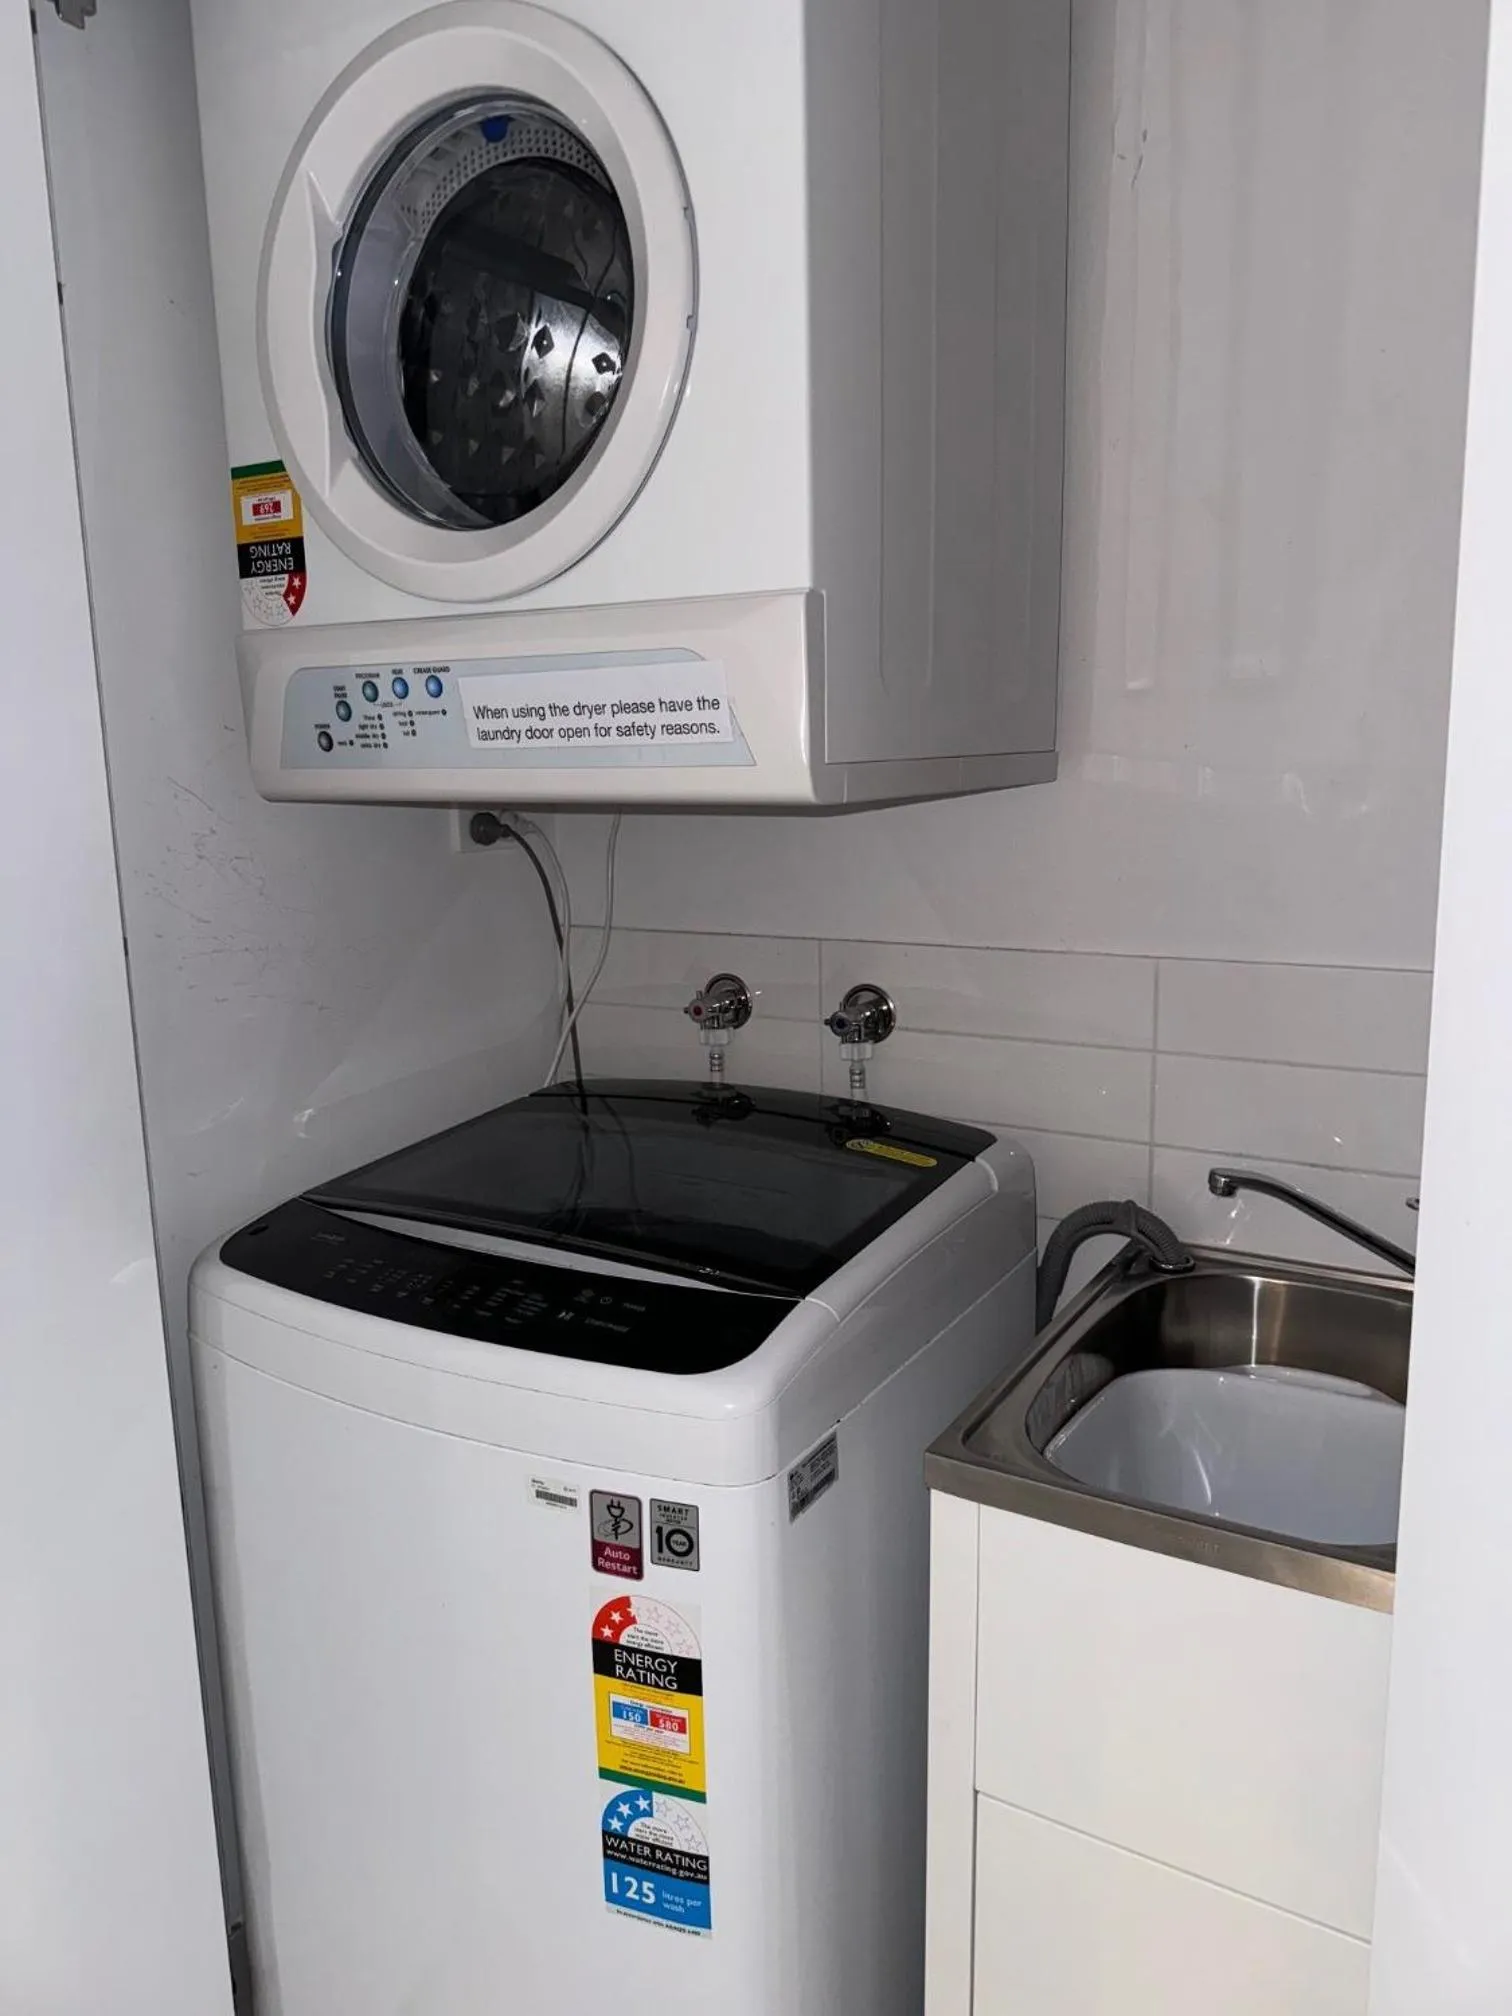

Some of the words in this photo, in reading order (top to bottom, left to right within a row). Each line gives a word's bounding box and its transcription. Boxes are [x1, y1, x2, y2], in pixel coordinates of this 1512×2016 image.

[250, 542, 291, 558] RATING
[250, 557, 294, 574] ENERGY
[473, 704, 509, 720] When
[511, 703, 546, 721] using
[548, 702, 570, 717] the
[573, 701, 606, 719] dryer
[611, 699, 655, 718] please
[658, 695, 693, 712] have
[696, 695, 720, 711] the
[476, 725, 521, 744] laundry
[525, 725, 554, 740] door
[558, 726, 590, 742] open
[593, 722, 612, 738] for
[616, 721, 657, 740] safety
[660, 722, 720, 736] reasons.
[657, 1504, 689, 1516] SMART
[604, 1546, 630, 1560] Auto
[656, 1525, 694, 1558] 10
[597, 1556, 638, 1575] Restart
[614, 1648, 678, 1674] ENERGY
[615, 1664, 678, 1690] RATING
[623, 1710, 642, 1722] 150
[605, 1835, 652, 1858] WATER
[655, 1849, 708, 1871] RATING
[611, 1871, 656, 1904] 125
